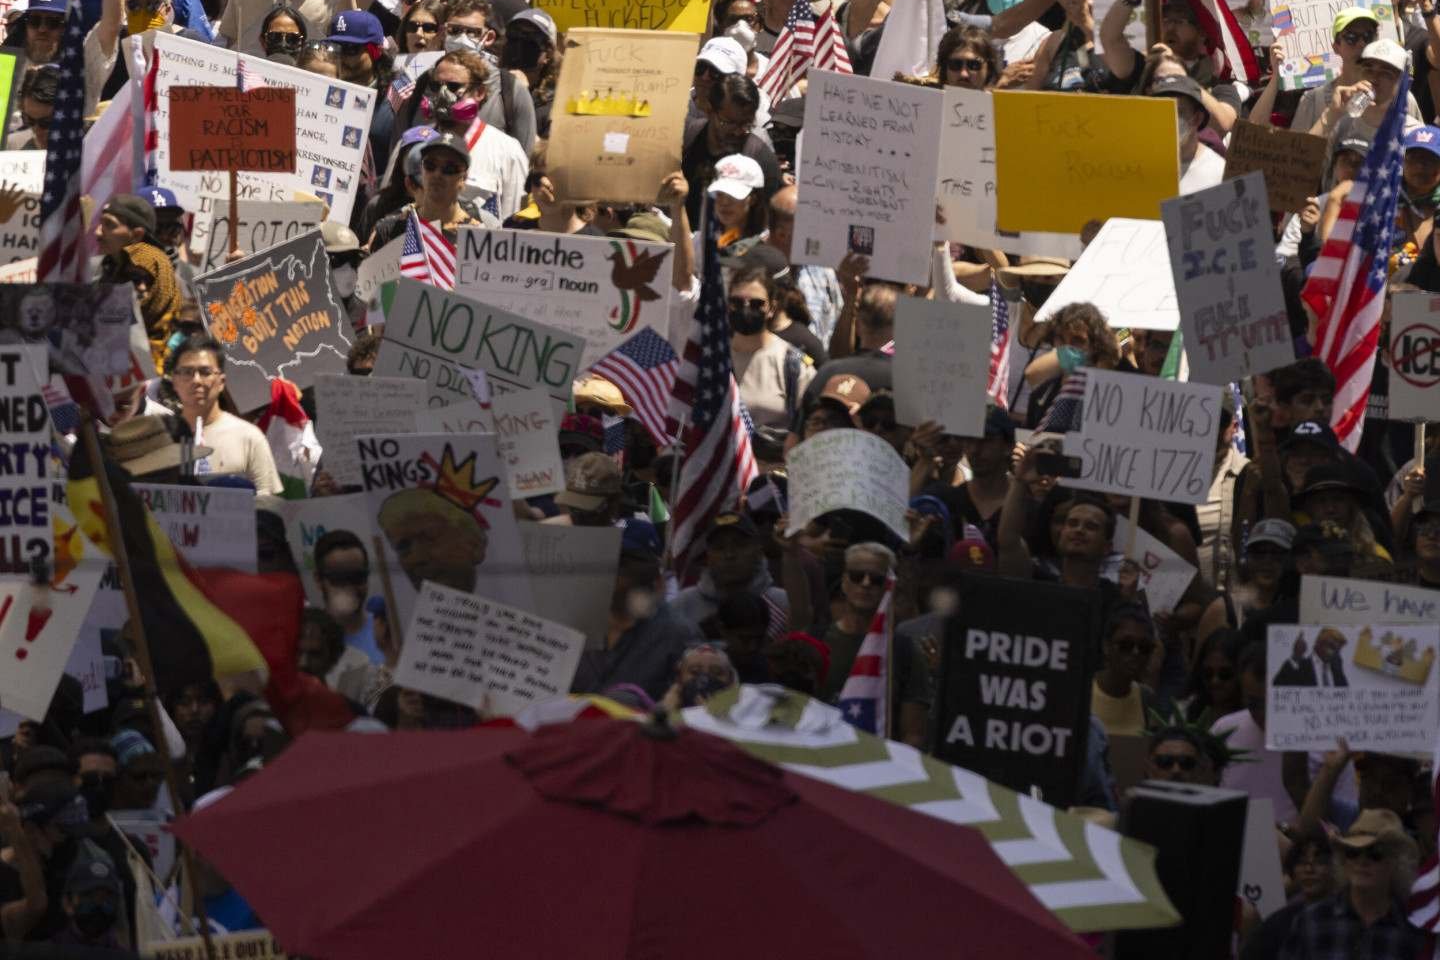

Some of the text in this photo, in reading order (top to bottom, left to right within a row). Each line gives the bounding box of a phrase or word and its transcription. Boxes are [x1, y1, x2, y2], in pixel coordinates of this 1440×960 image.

[584, 5, 669, 31] FUCKED
[1086, 383, 1213, 437] NO KINGS
[358, 438, 400, 461] NO
[1082, 440, 1204, 495] SINCE 1776
[361, 459, 432, 492] KINGS
[964, 628, 1069, 671] PRIDE
[979, 674, 1046, 711] WAS
[948, 715, 1073, 757] A RIOT
